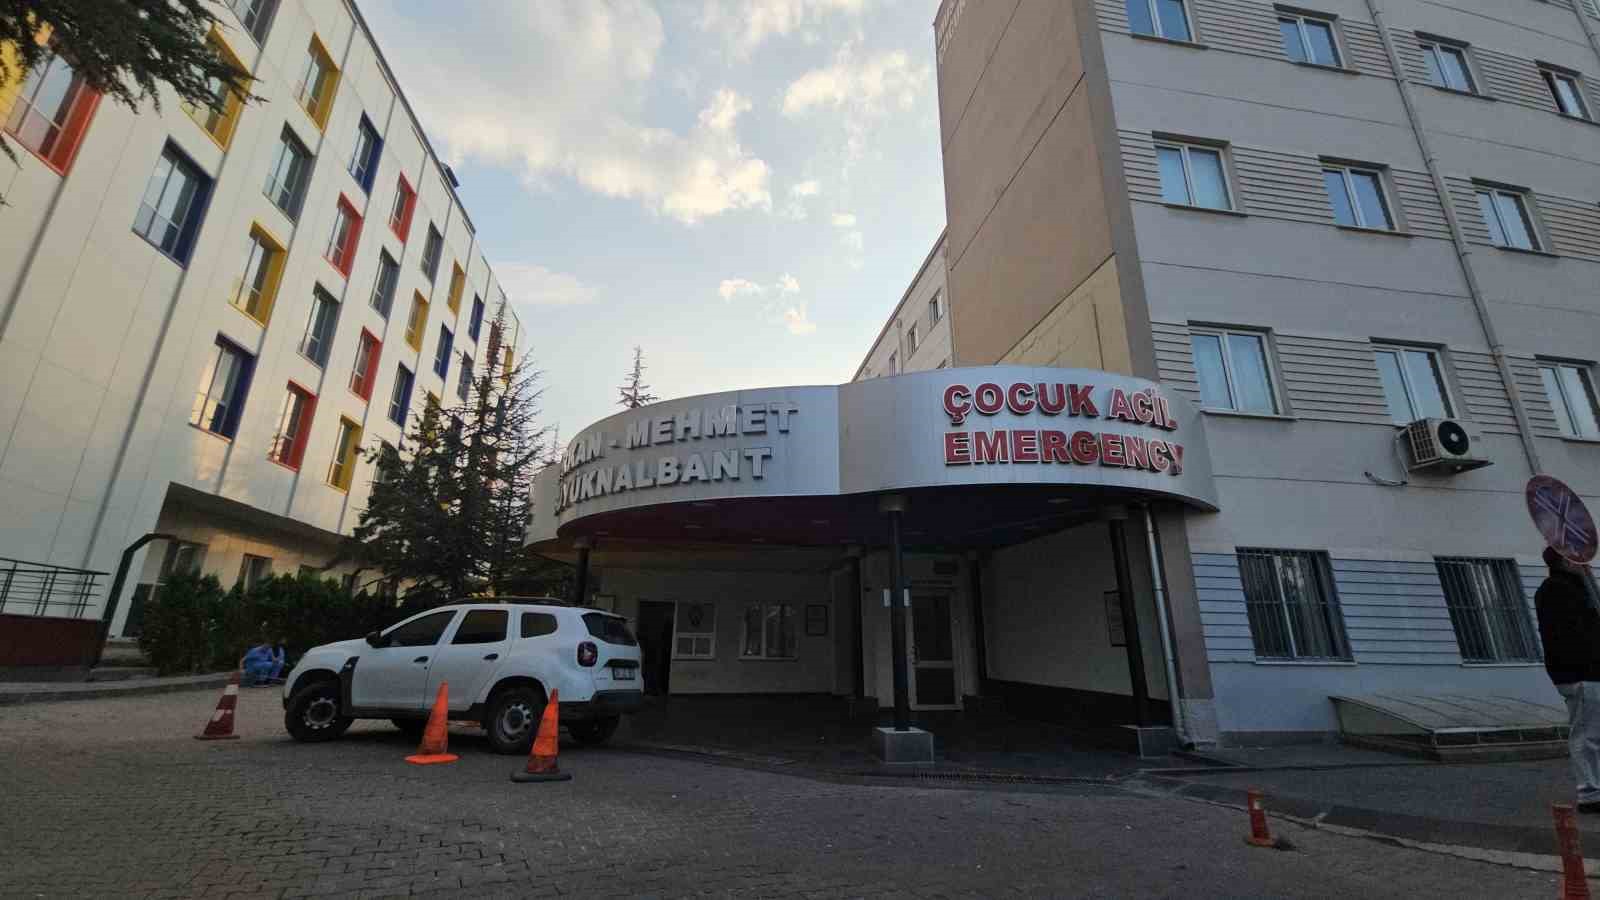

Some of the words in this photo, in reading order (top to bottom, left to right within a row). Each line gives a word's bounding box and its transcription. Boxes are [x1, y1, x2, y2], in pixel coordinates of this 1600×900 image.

[625, 402, 798, 450] MEHMET
[943, 382, 1099, 424] ÇOCUK
[1108, 387, 1178, 431] ACİL
[943, 429, 1185, 475] EMERGENCY
[559, 446, 772, 508] YÜKNALBANT
